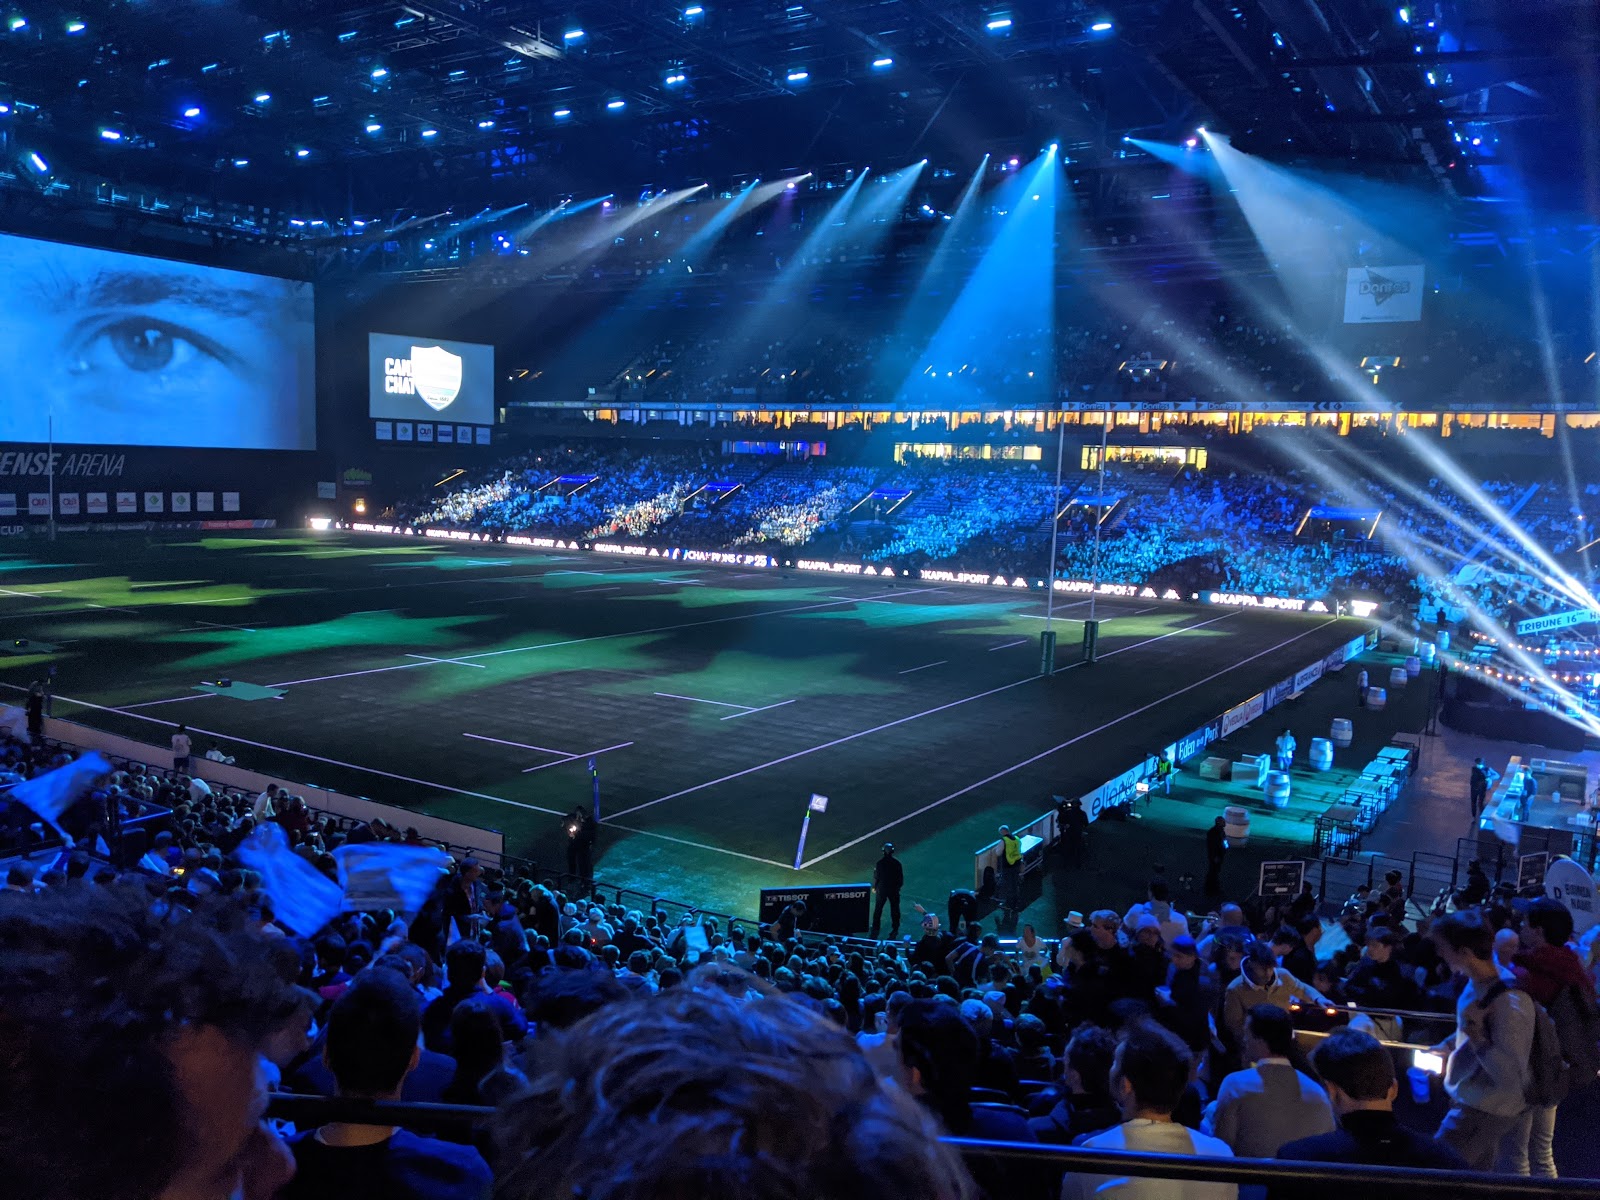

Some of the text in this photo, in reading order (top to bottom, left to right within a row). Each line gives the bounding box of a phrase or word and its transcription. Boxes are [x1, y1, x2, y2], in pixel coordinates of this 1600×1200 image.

[0, 451, 125, 476] ENSE ARENA
[0, 525, 24, 536] CUP
[1518, 616, 1562, 632] TRIBUNE
[1179, 722, 1220, 761] Eden Park
[778, 893, 809, 902] TISSOT
[837, 891, 867, 899] TISSOT
